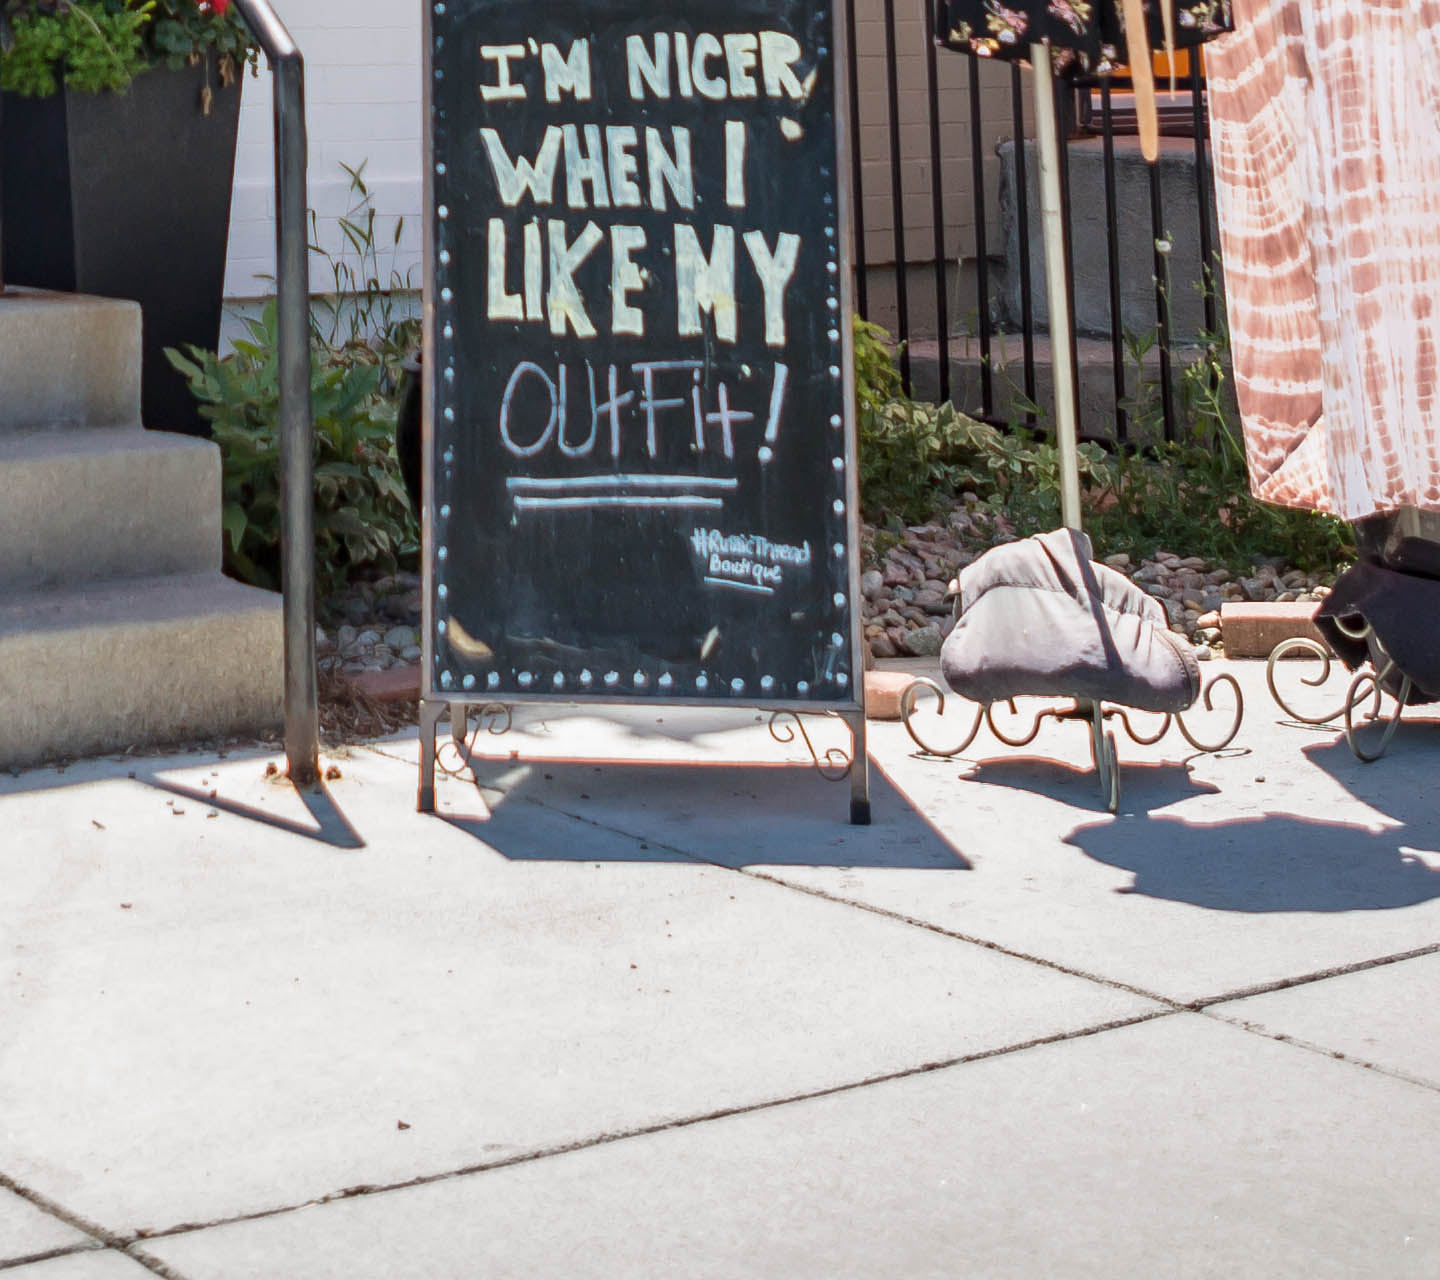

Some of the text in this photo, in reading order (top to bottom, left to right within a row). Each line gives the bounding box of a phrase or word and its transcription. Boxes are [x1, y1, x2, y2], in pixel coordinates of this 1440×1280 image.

[480, 37, 592, 103] I'M
[480, 119, 746, 211] WHEN I
[487, 217, 802, 347] LIKE MY
